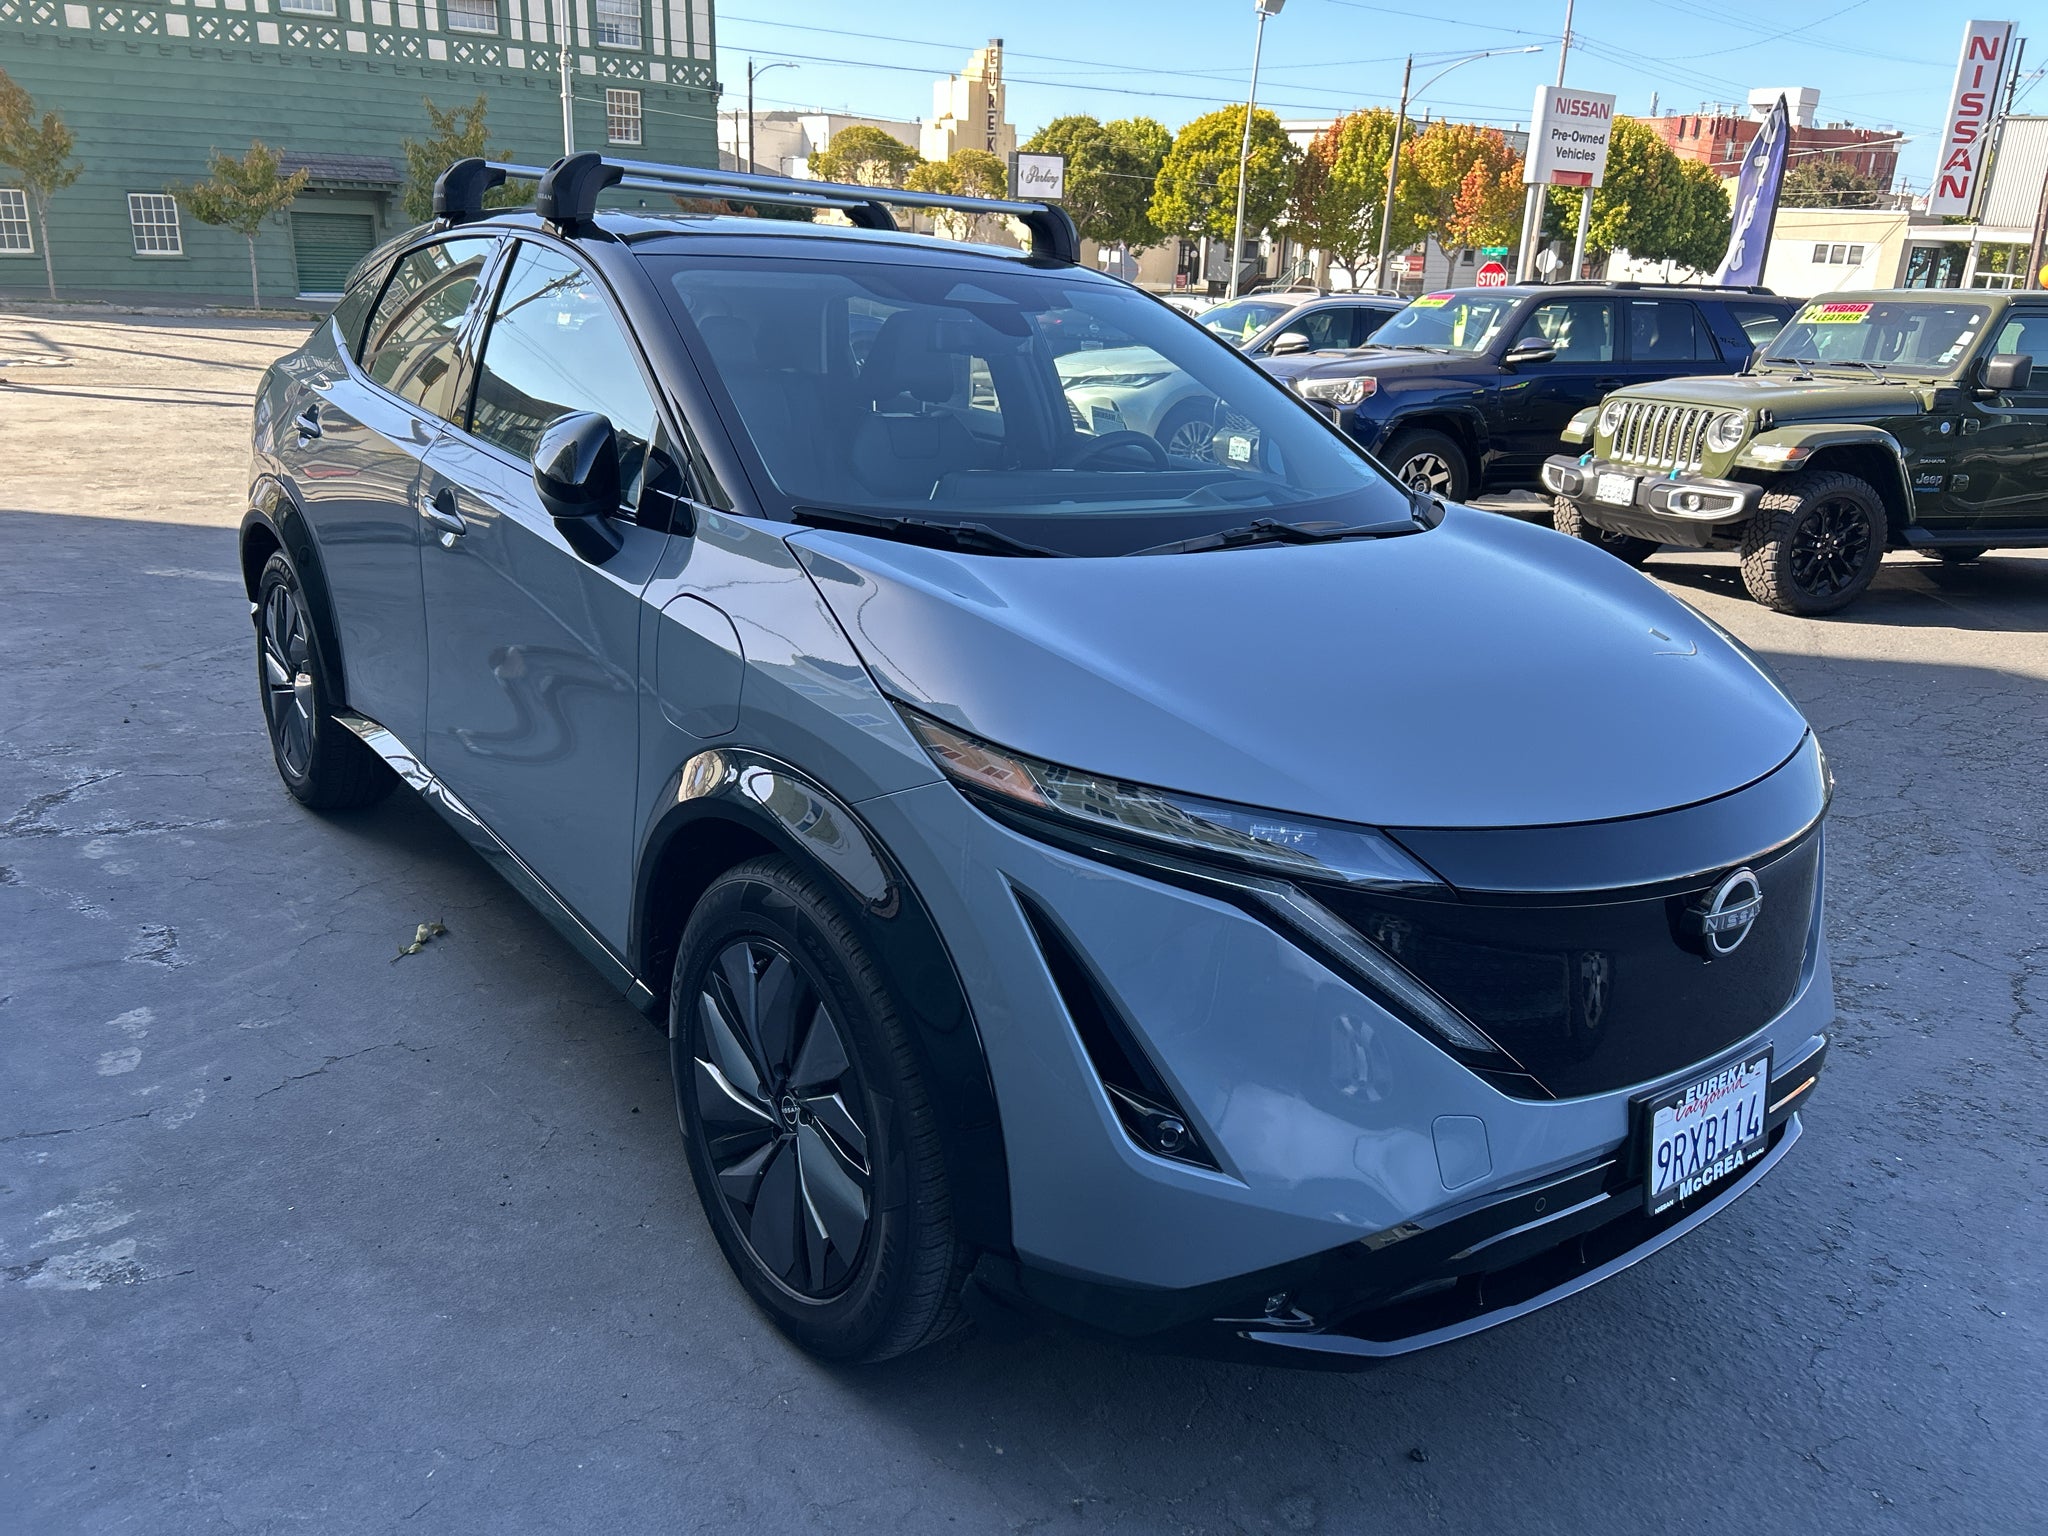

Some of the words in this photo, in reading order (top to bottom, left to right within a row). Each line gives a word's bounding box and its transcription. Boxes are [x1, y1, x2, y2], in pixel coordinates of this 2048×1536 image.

[987, 48, 998, 151] EUREK
[1555, 97, 1610, 119] NISSAN
[1938, 36, 2000, 199] NISSAN
[1551, 128, 1605, 145] Pre-Owned
[1556, 146, 1596, 161] Vehicles
[1025, 165, 1059, 189] Parking
[1479, 272, 1505, 286] STOP
[1816, 313, 1862, 321] LEATHER
[1823, 304, 1869, 313] HYBRID
[1915, 472, 1943, 487] Jeep
[1705, 903, 1761, 932] NISSAN
[1685, 1062, 1747, 1105] EUREKA
[1676, 1076, 1749, 1122] California
[1657, 1091, 1760, 1193] 9RXB114
[1679, 1149, 1744, 1201] McCREA
